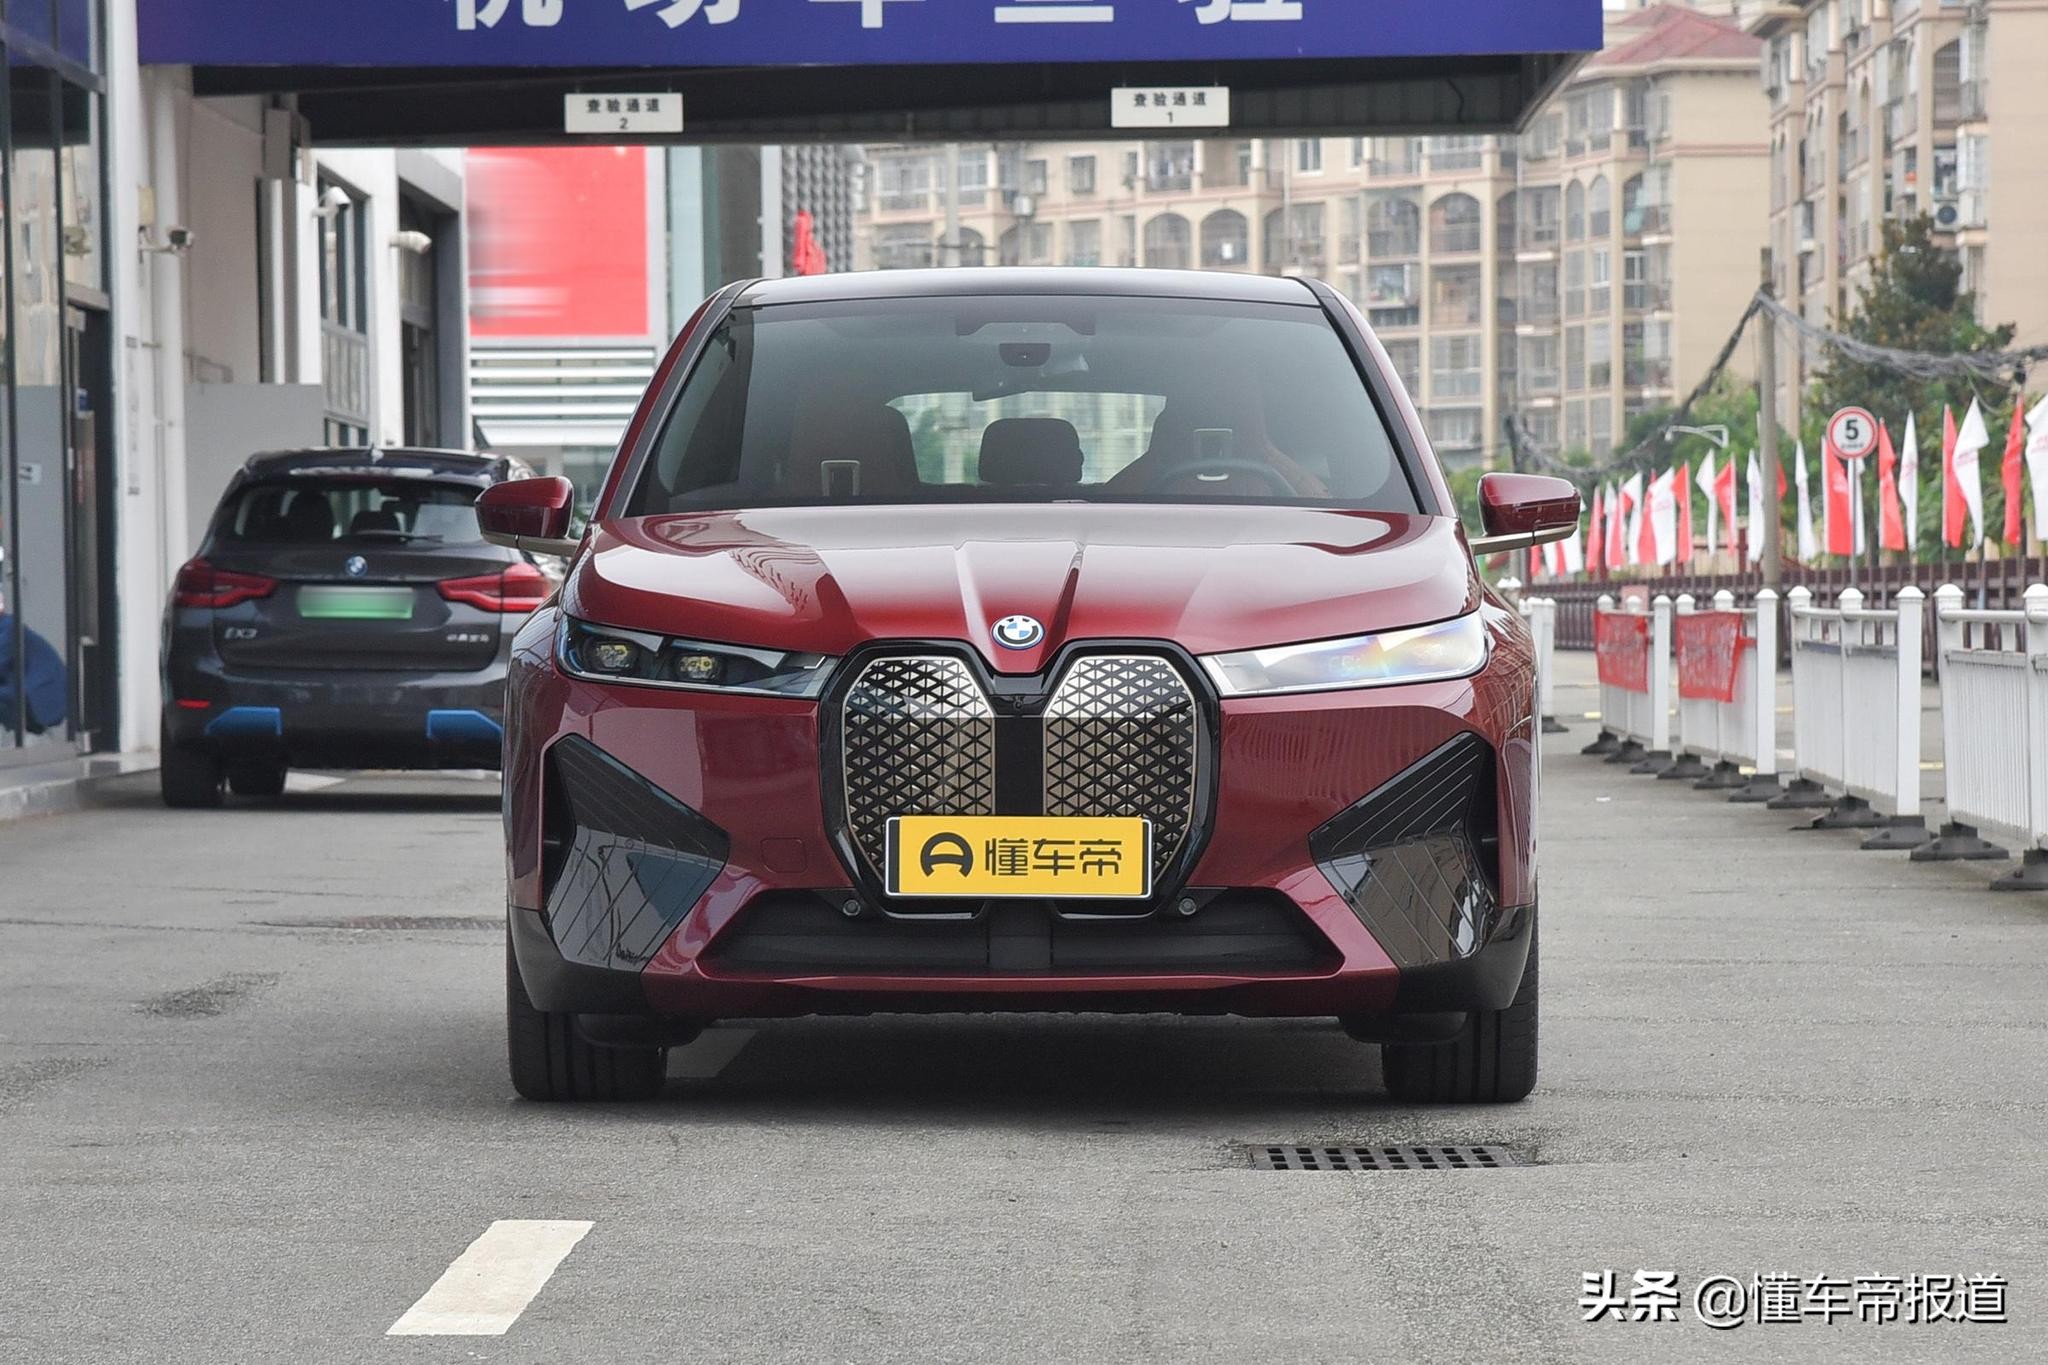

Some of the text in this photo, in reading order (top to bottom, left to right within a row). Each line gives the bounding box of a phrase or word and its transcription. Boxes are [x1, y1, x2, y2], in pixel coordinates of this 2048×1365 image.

[587, 98, 659, 113] 查验通道
[1134, 92, 1206, 106] 查验通道
[619, 117, 628, 130] 2
[1167, 111, 1174, 123] 1
[1845, 419, 1859, 440] 5
[985, 837, 1122, 877] 懂车帝
